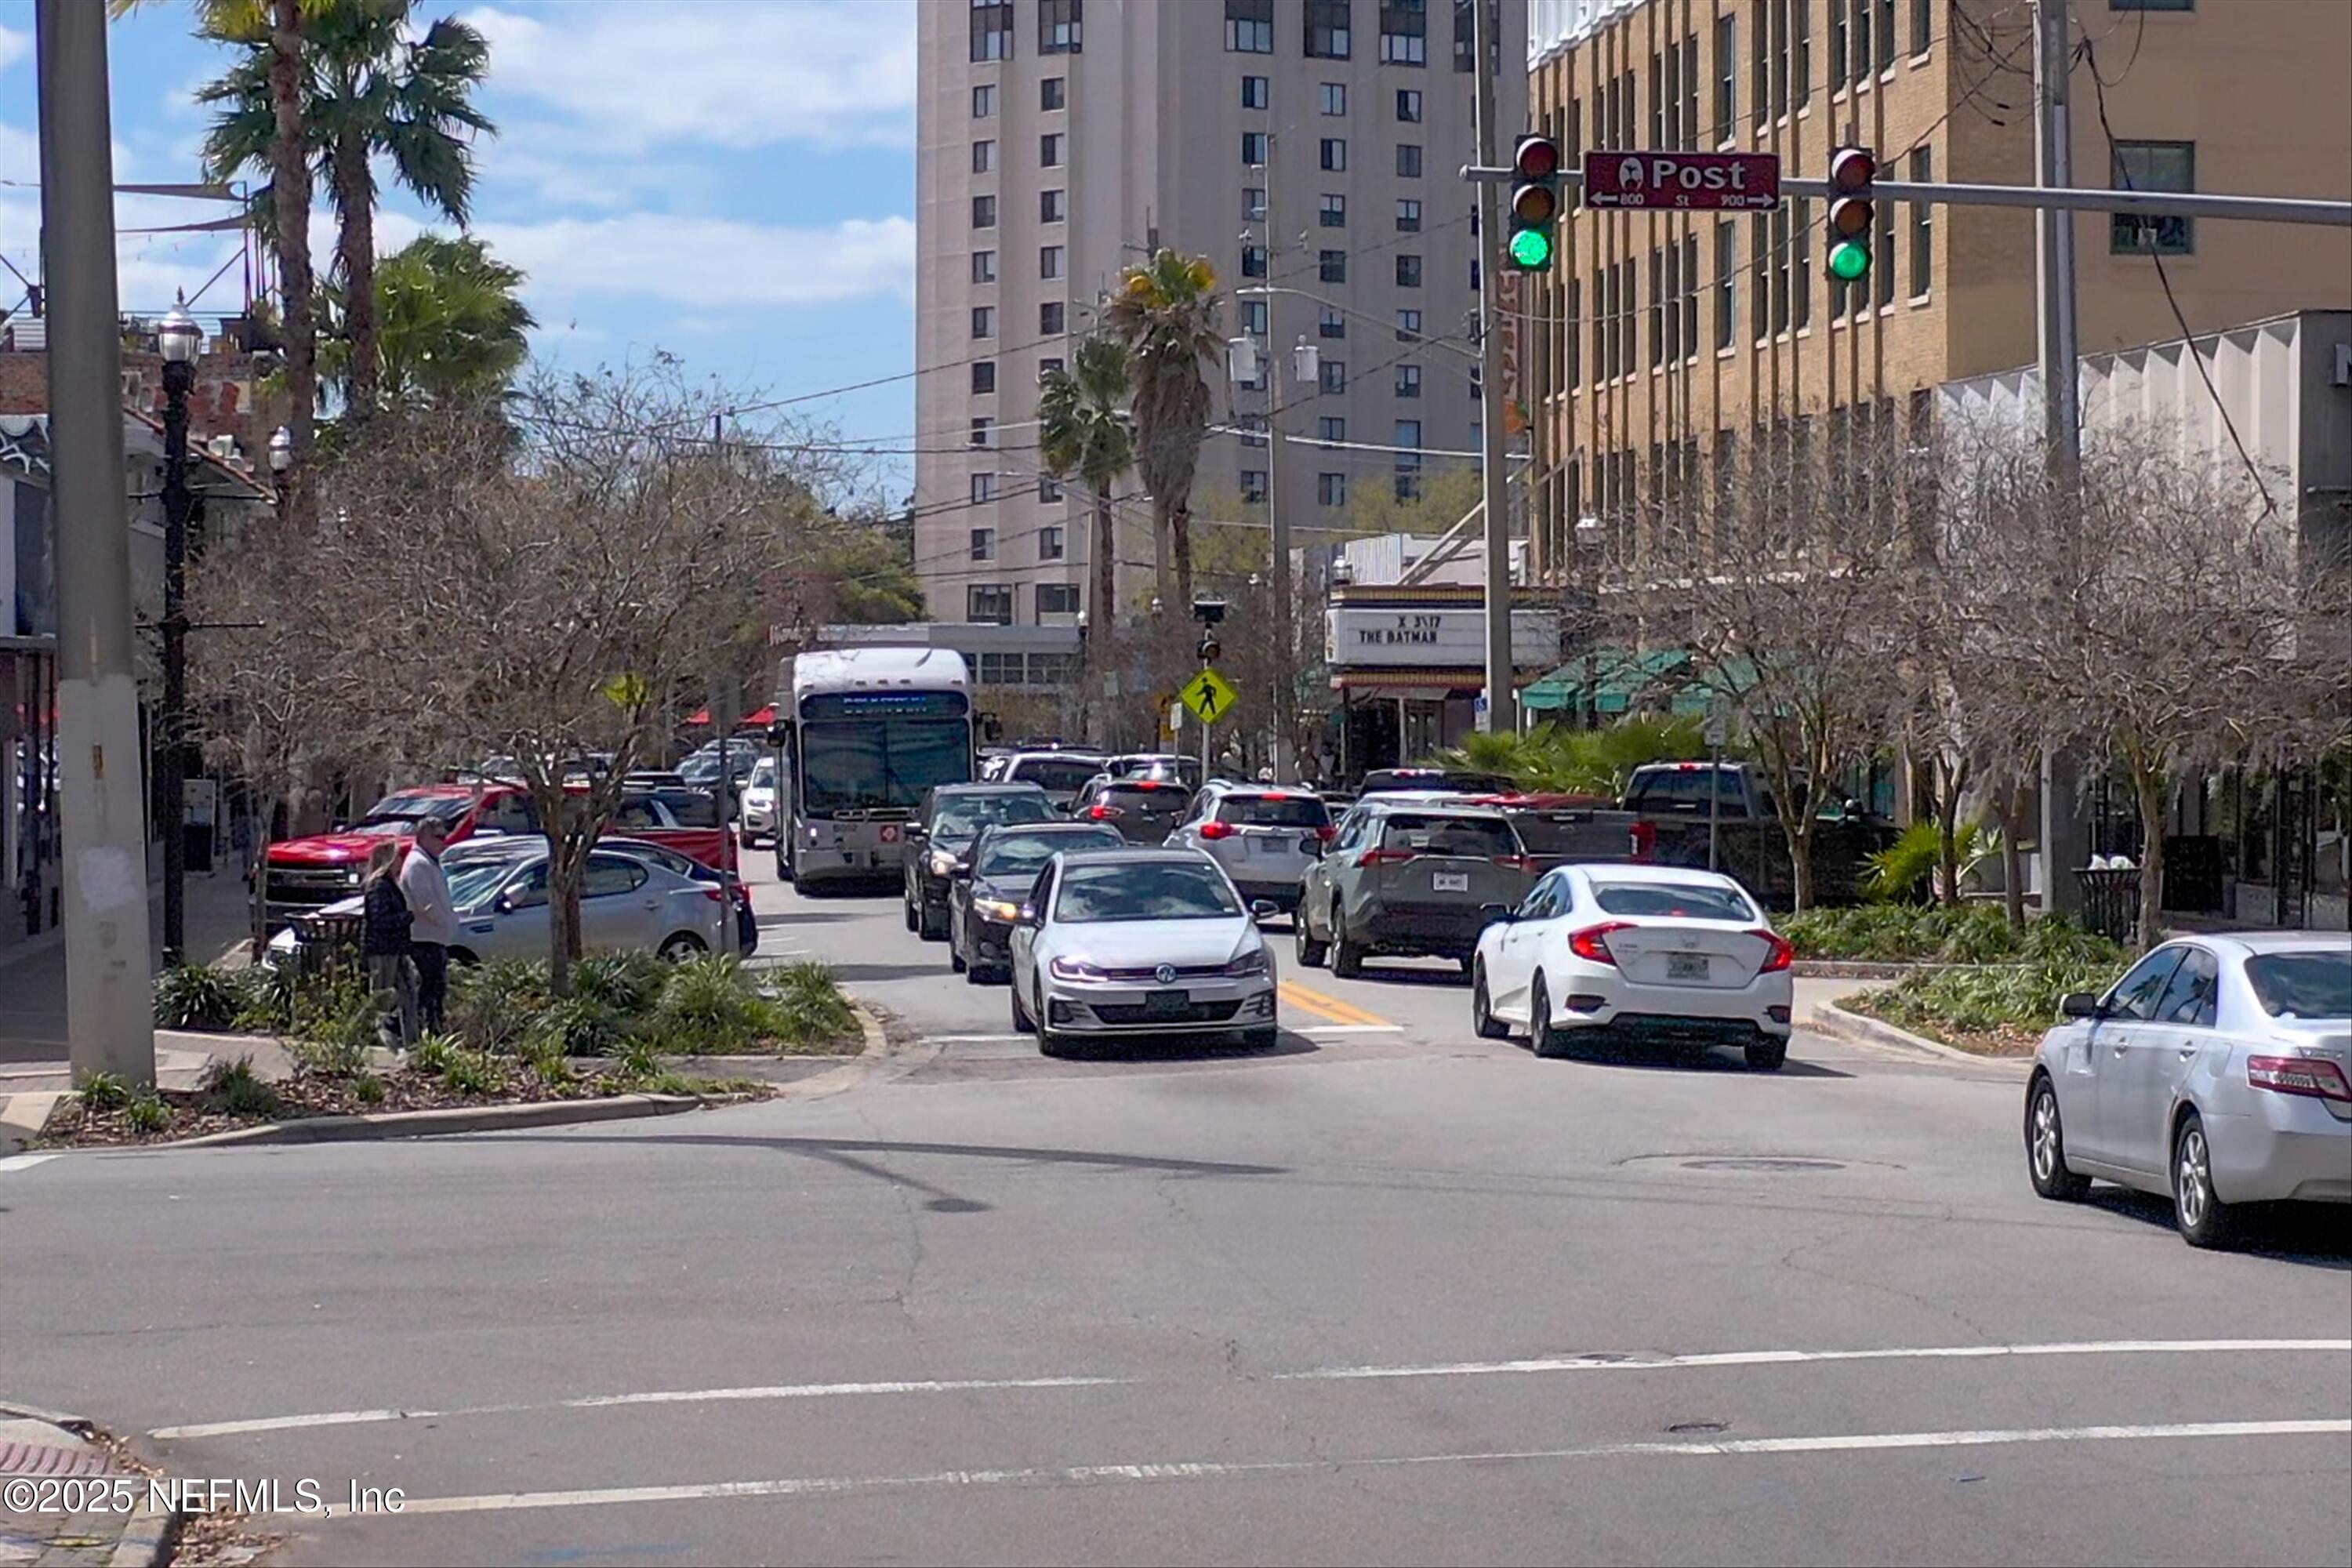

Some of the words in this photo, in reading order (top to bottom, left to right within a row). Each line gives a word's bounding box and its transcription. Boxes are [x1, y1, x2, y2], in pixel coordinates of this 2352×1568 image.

[1653, 159, 1747, 190] Post
[1620, 194, 1644, 205] 800
[1675, 194, 1690, 206] St
[1721, 194, 1744, 206] 900
[1398, 615, 1406, 628] X
[1359, 630, 1382, 644] THE
[1387, 630, 1437, 644] BATMAN
